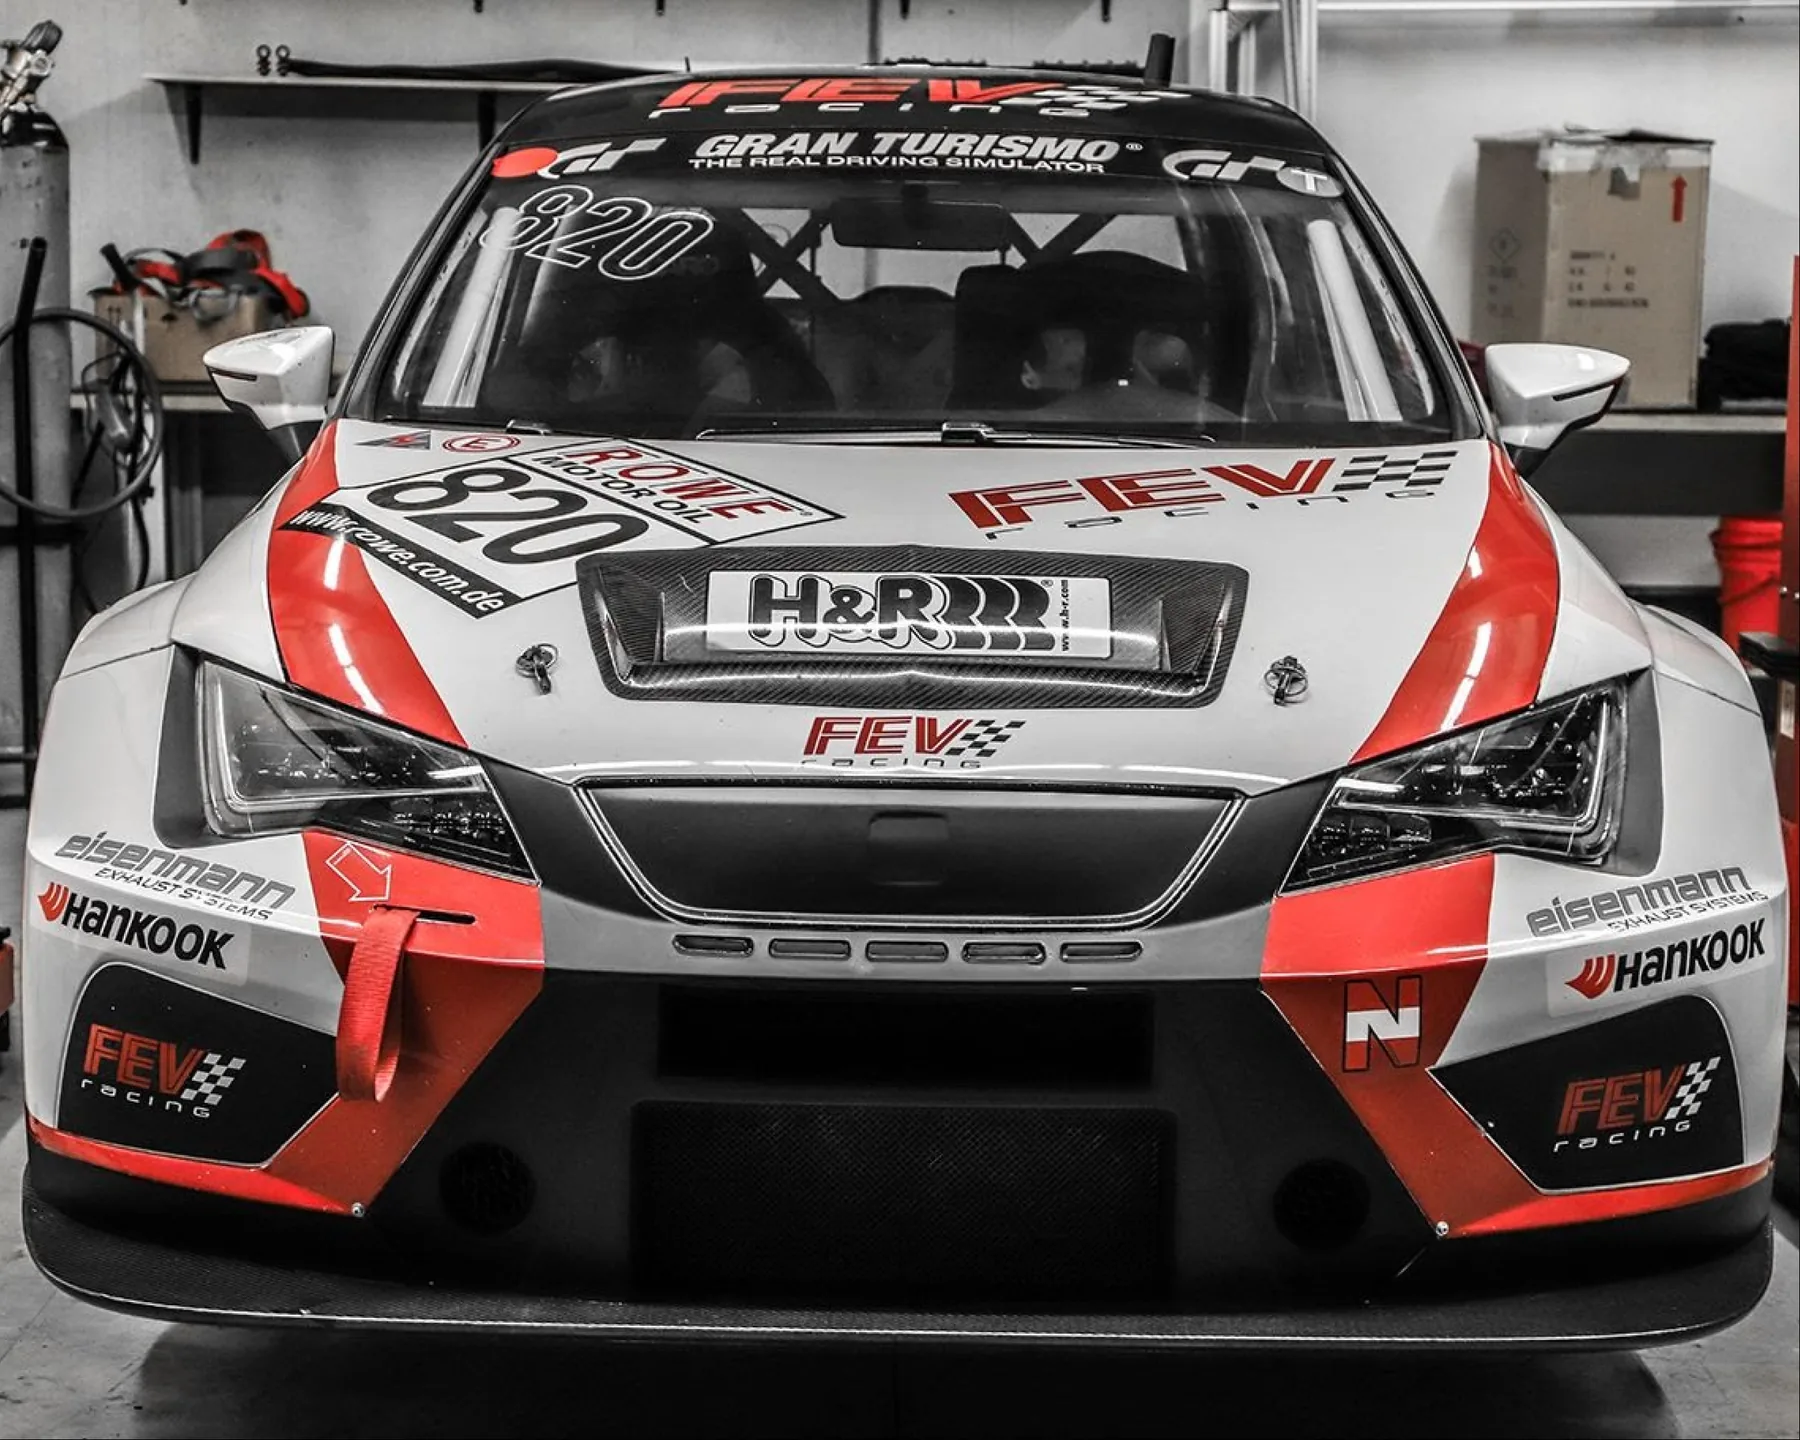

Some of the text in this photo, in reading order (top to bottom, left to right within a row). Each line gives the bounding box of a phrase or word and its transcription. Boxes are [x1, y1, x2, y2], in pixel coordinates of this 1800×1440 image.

[657, 78, 1066, 107] FEV
[688, 156, 1105, 173] THE REAL DRIVING SIMULATOR
[696, 132, 1120, 162] GRAN TURISMO
[479, 184, 715, 281] 820
[366, 466, 650, 565] 820
[532, 455, 715, 524] MOTOR OIL
[564, 446, 793, 519] ROWE
[948, 457, 1336, 529] FEV
[290, 510, 506, 613] www.rowe.com.de
[803, 716, 974, 756] FEV
[55, 831, 296, 910] eisenmann
[94, 867, 183, 894] EXHAUST
[1525, 867, 1752, 938] eisenmann
[1607, 890, 1769, 932] EXHAUST SYSTEMS
[83, 1023, 205, 1096] FEV
[1343, 975, 1422, 1073] N
[1556, 1063, 1687, 1135] FEV
